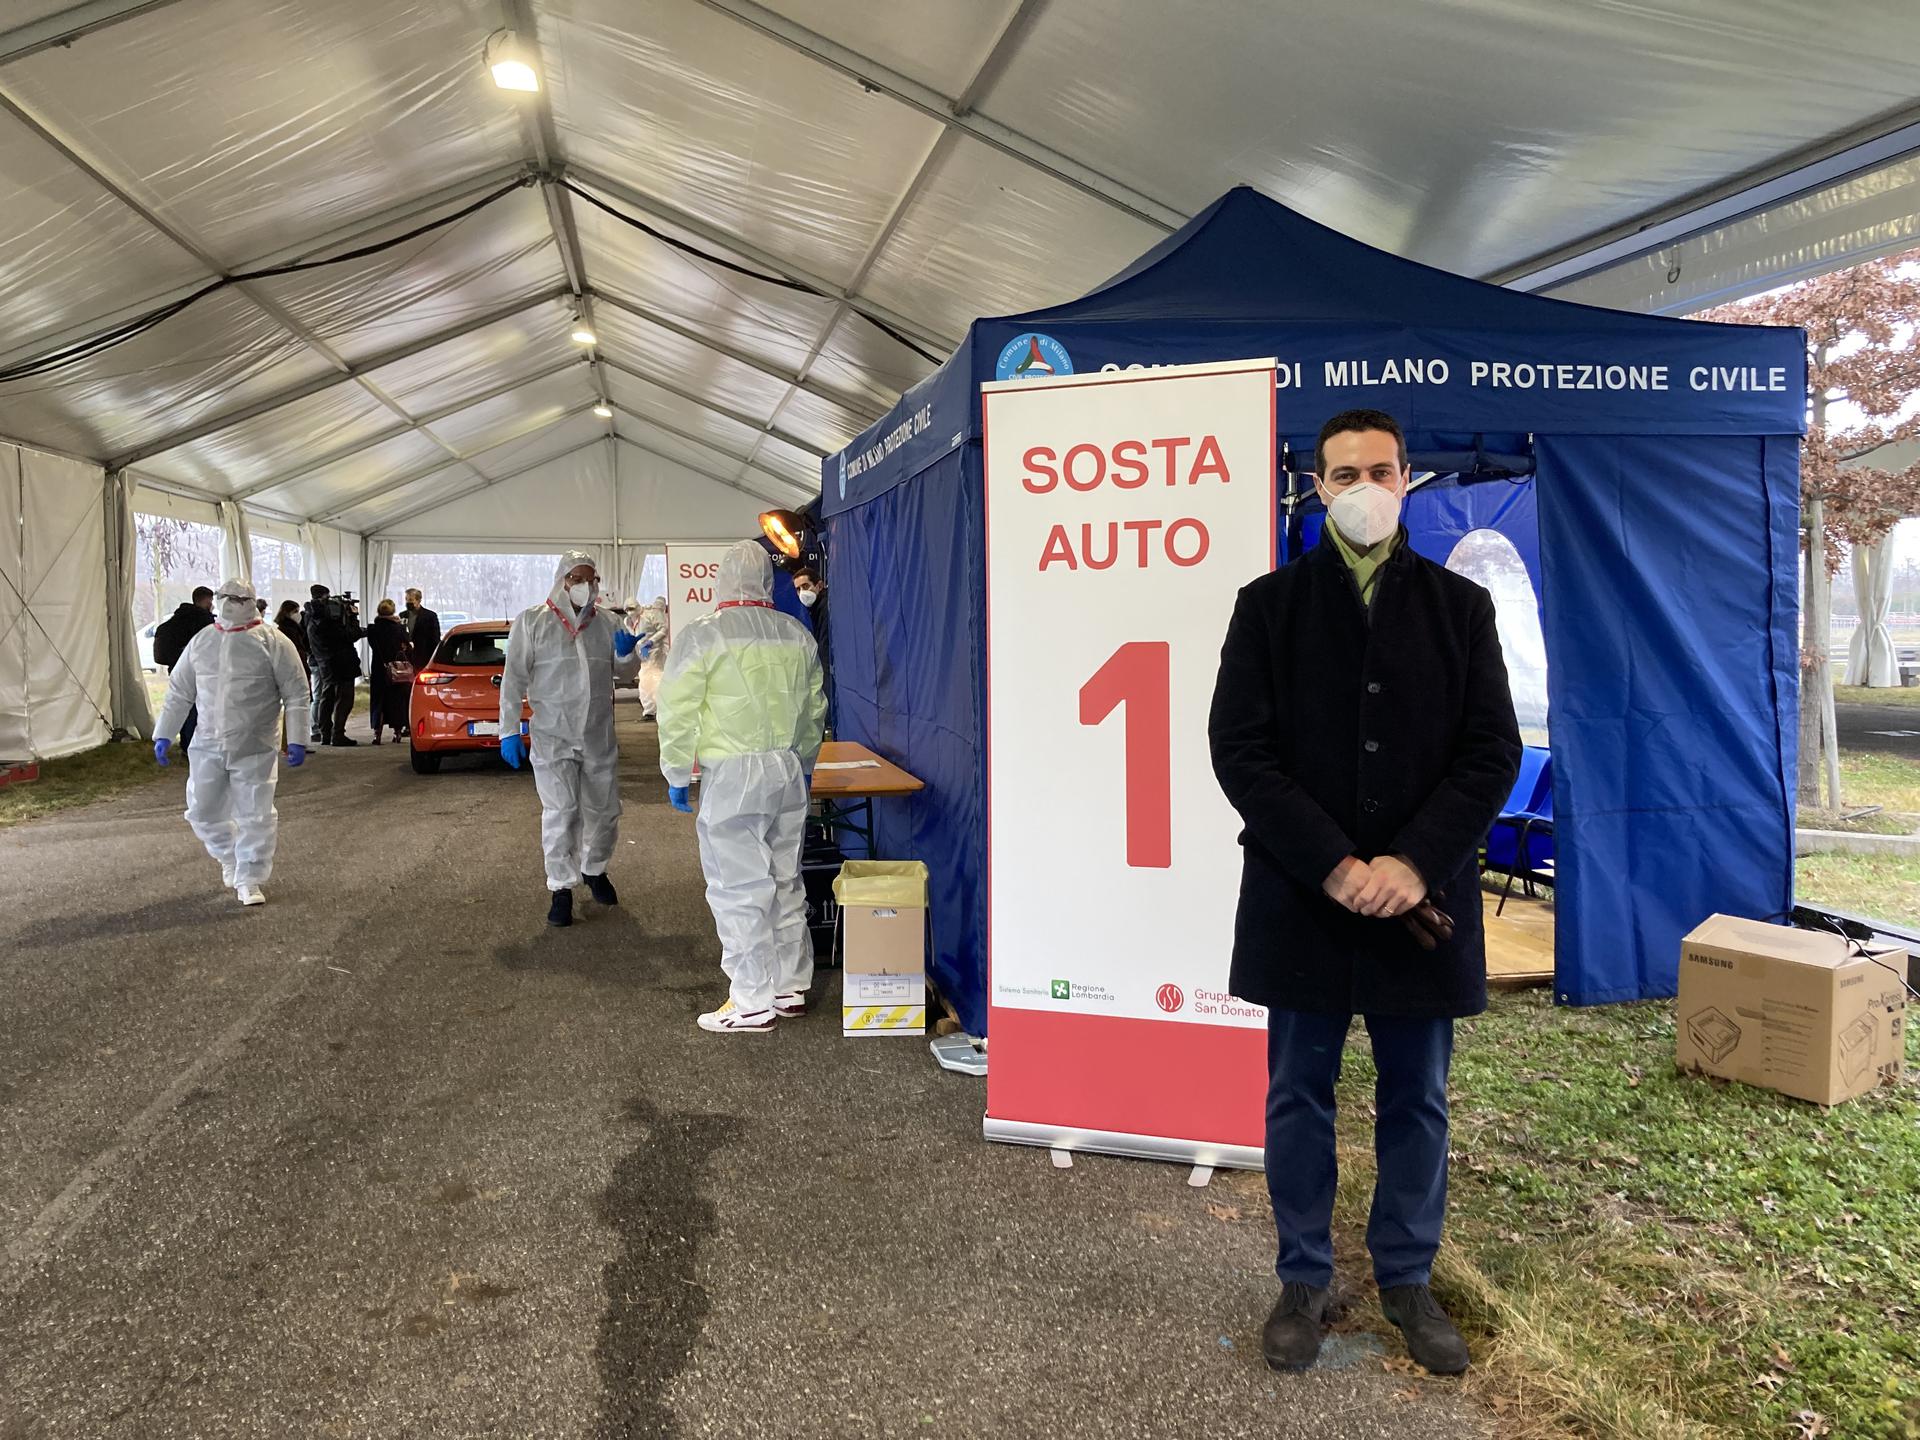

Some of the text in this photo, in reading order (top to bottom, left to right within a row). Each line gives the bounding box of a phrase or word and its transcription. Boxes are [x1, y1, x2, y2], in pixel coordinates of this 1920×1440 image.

[999, 338, 1070, 370] Comune di Milano
[1276, 359, 1787, 392] DI MILANO PROTEZIONE CIVILE
[1022, 435, 1231, 494] SOSTA
[1039, 517, 1210, 571] AUTO
[680, 563, 719, 578] SOS
[686, 587, 713, 603] AU
[1079, 641, 1171, 869] 1
[1688, 953, 1734, 970] SAMSUNG
[1072, 983, 1105, 993] Regione
[1072, 990, 1115, 1001] Lombardia
[1194, 988, 1240, 1004] Gruppo
[1194, 1001, 1265, 1018] San Donato
